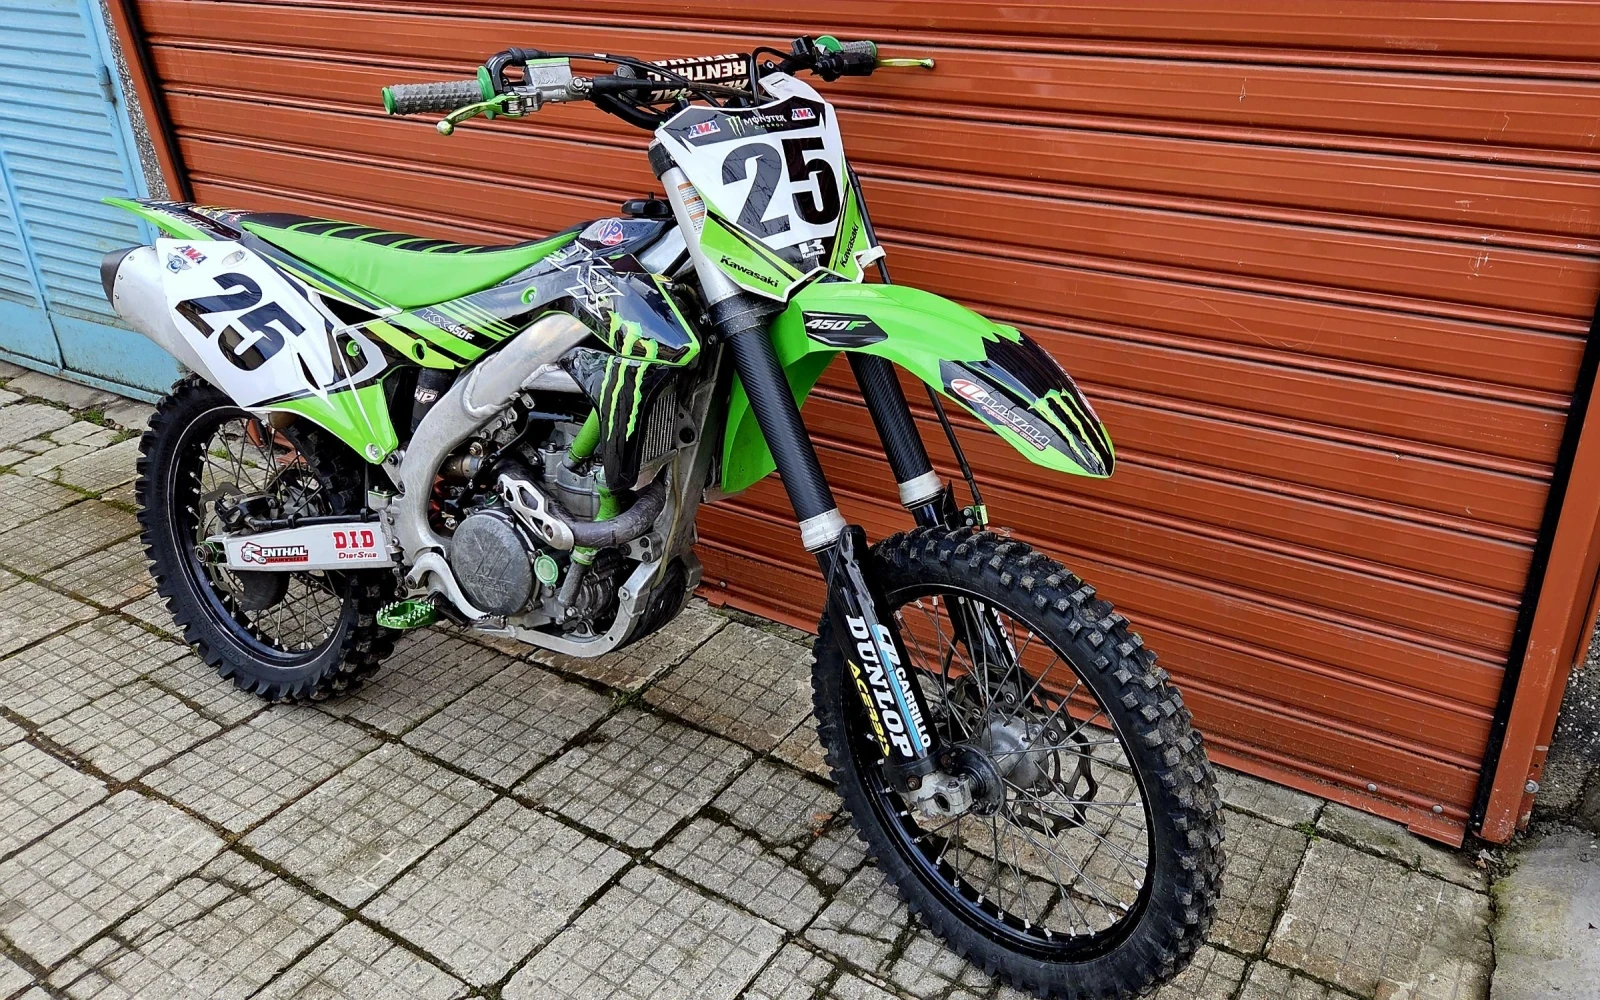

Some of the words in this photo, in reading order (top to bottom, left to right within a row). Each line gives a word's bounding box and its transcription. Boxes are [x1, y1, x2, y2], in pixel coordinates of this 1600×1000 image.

[742, 114, 787, 126] MONSTER
[792, 109, 815, 119] AMA
[688, 120, 720, 139] AMA
[721, 136, 840, 239] 25
[840, 221, 860, 268] Kawasaki
[173, 245, 208, 265] AMA
[720, 255, 779, 288] Kawasaki
[175, 272, 306, 371] 25
[805, 319, 871, 331] 450F
[409, 388, 436, 405] WP
[332, 530, 375, 549] D.I.D
[846, 614, 914, 758] DUNLOP
[895, 667, 932, 748] CARRILLO
